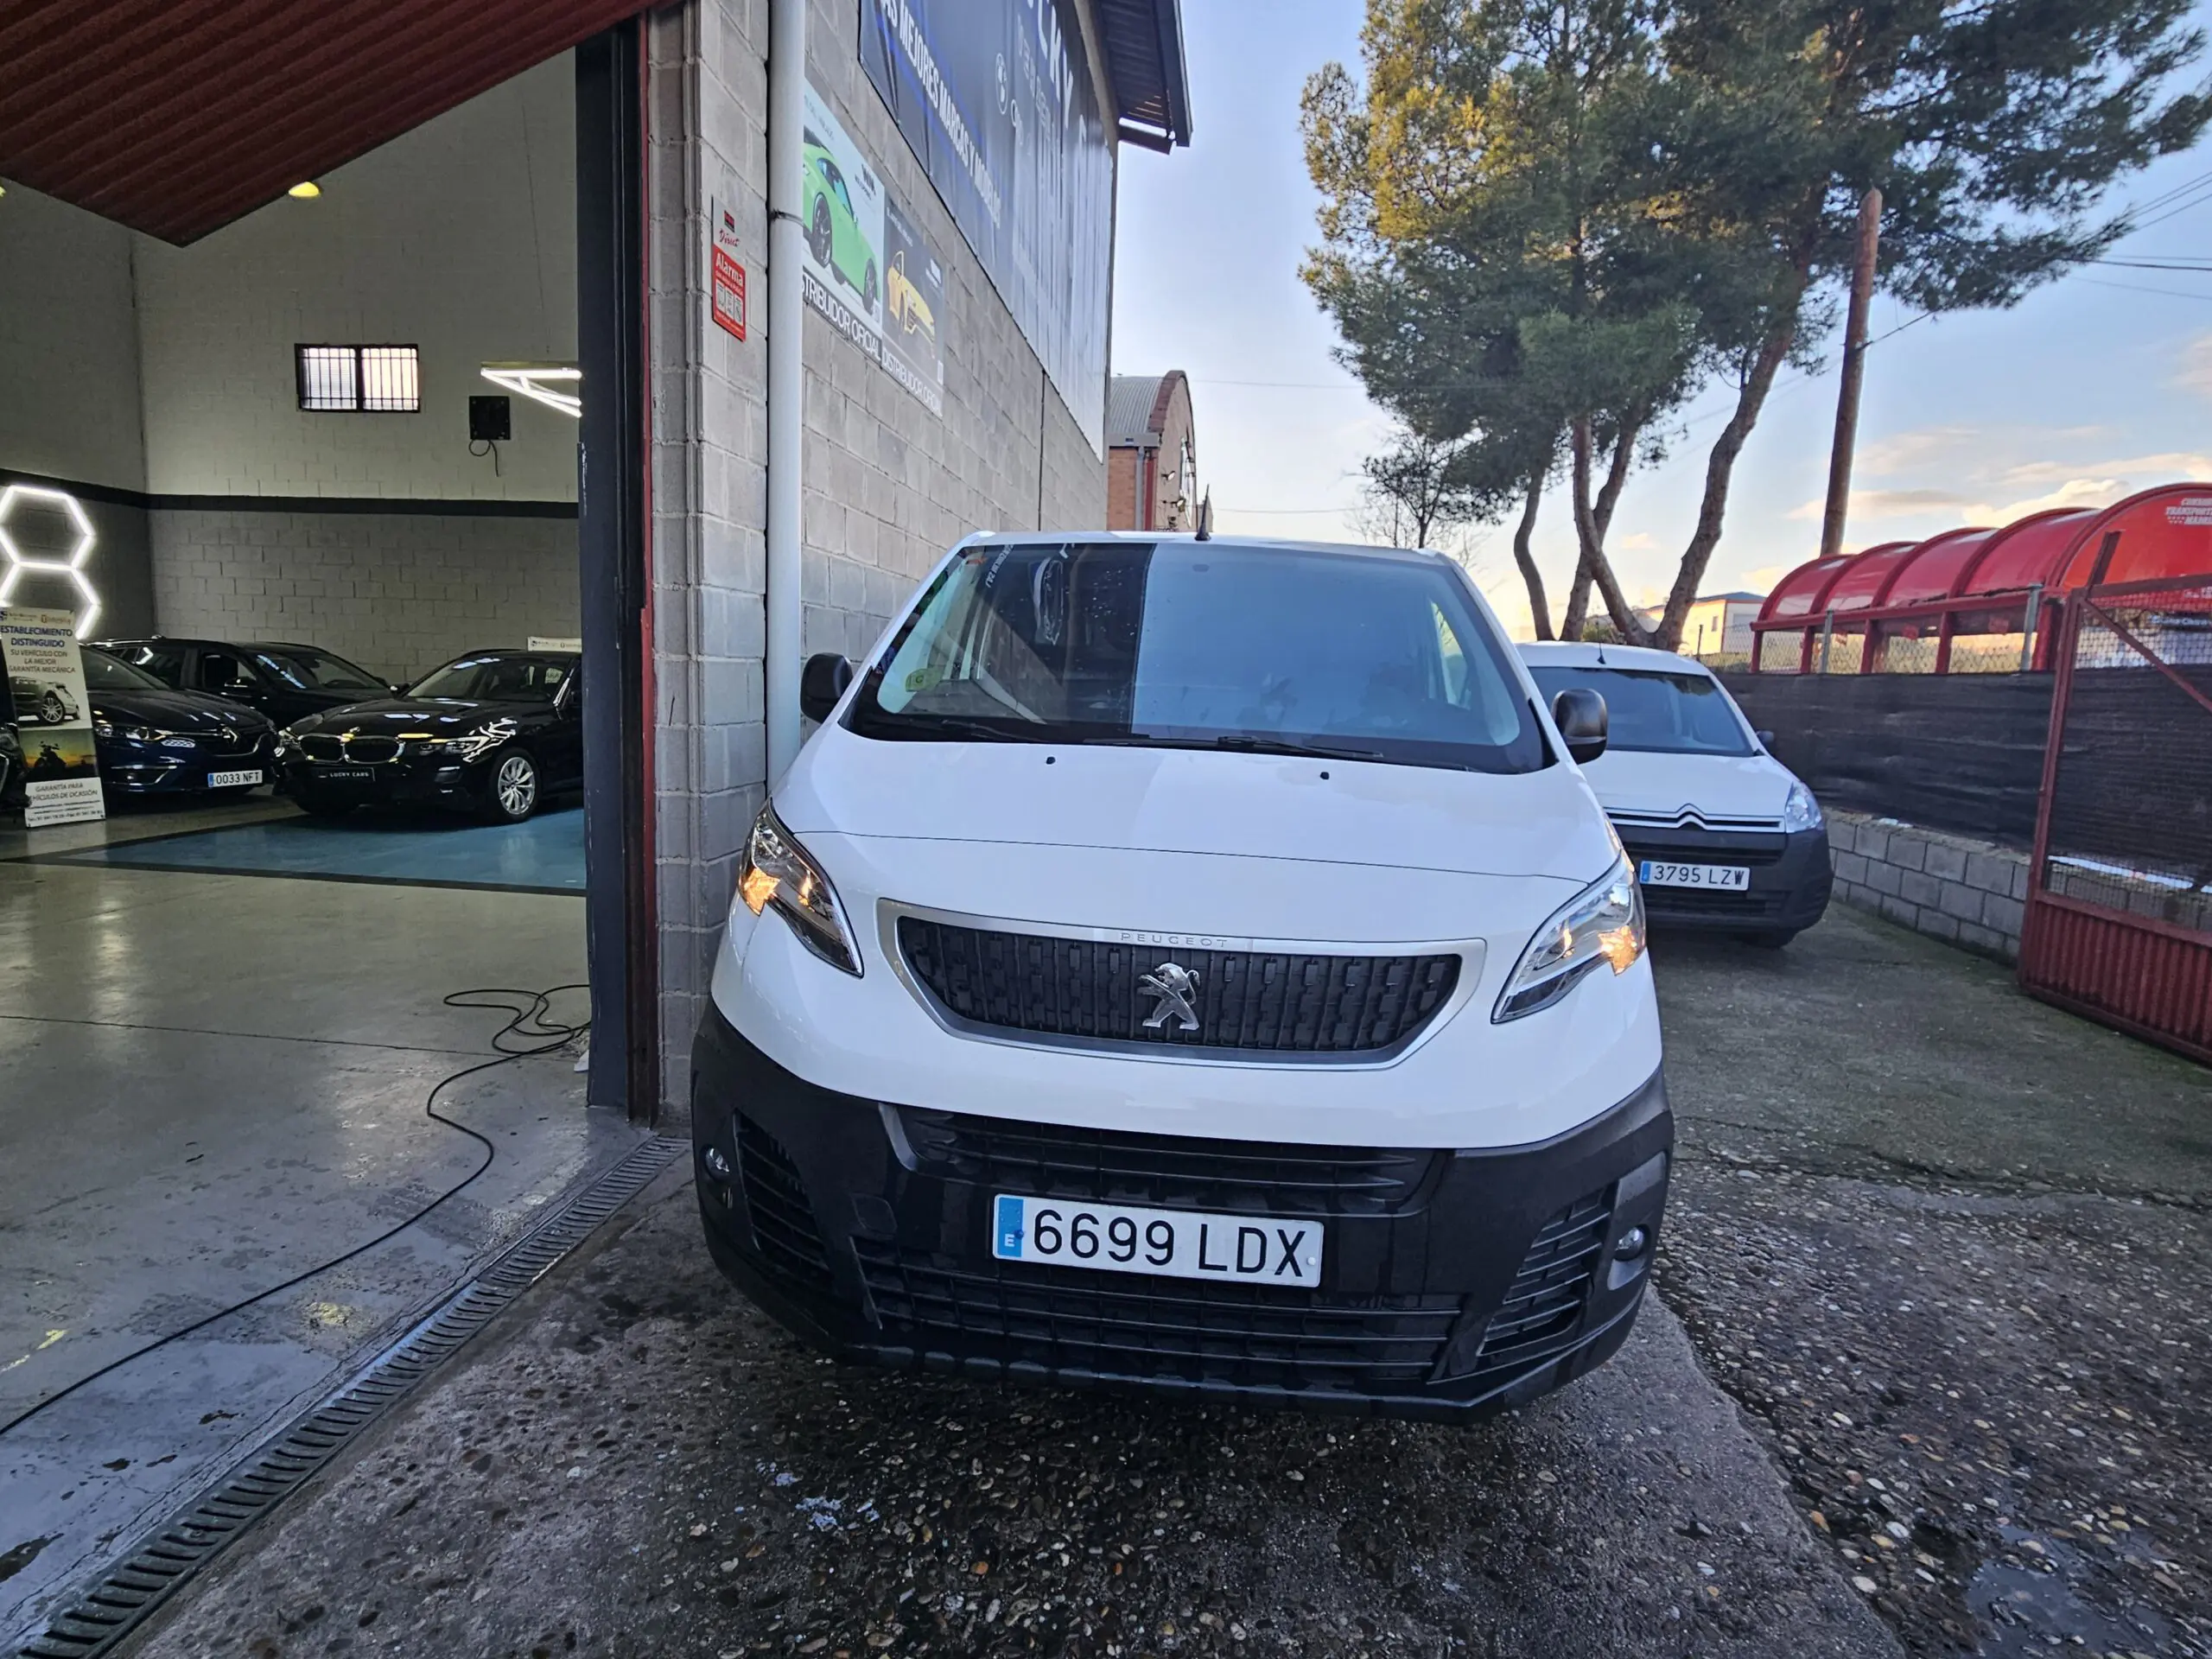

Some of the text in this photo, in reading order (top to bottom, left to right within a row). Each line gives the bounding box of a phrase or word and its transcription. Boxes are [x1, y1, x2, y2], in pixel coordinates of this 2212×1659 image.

[899, 0, 939, 109] MEJORES
[939, 79, 969, 168] MARCAS
[969, 140, 976, 177] Y
[715, 251, 744, 288] Alarma
[851, 320, 881, 361] OFICIAL
[10, 638, 66, 648] DISTINGUIDO
[216, 772, 259, 785] 0033 NFT
[1654, 865, 1745, 886] 3795 LZW
[1121, 932, 1228, 948] PEUGEOT
[1004, 1209, 1306, 1278] E 6699 LDX
